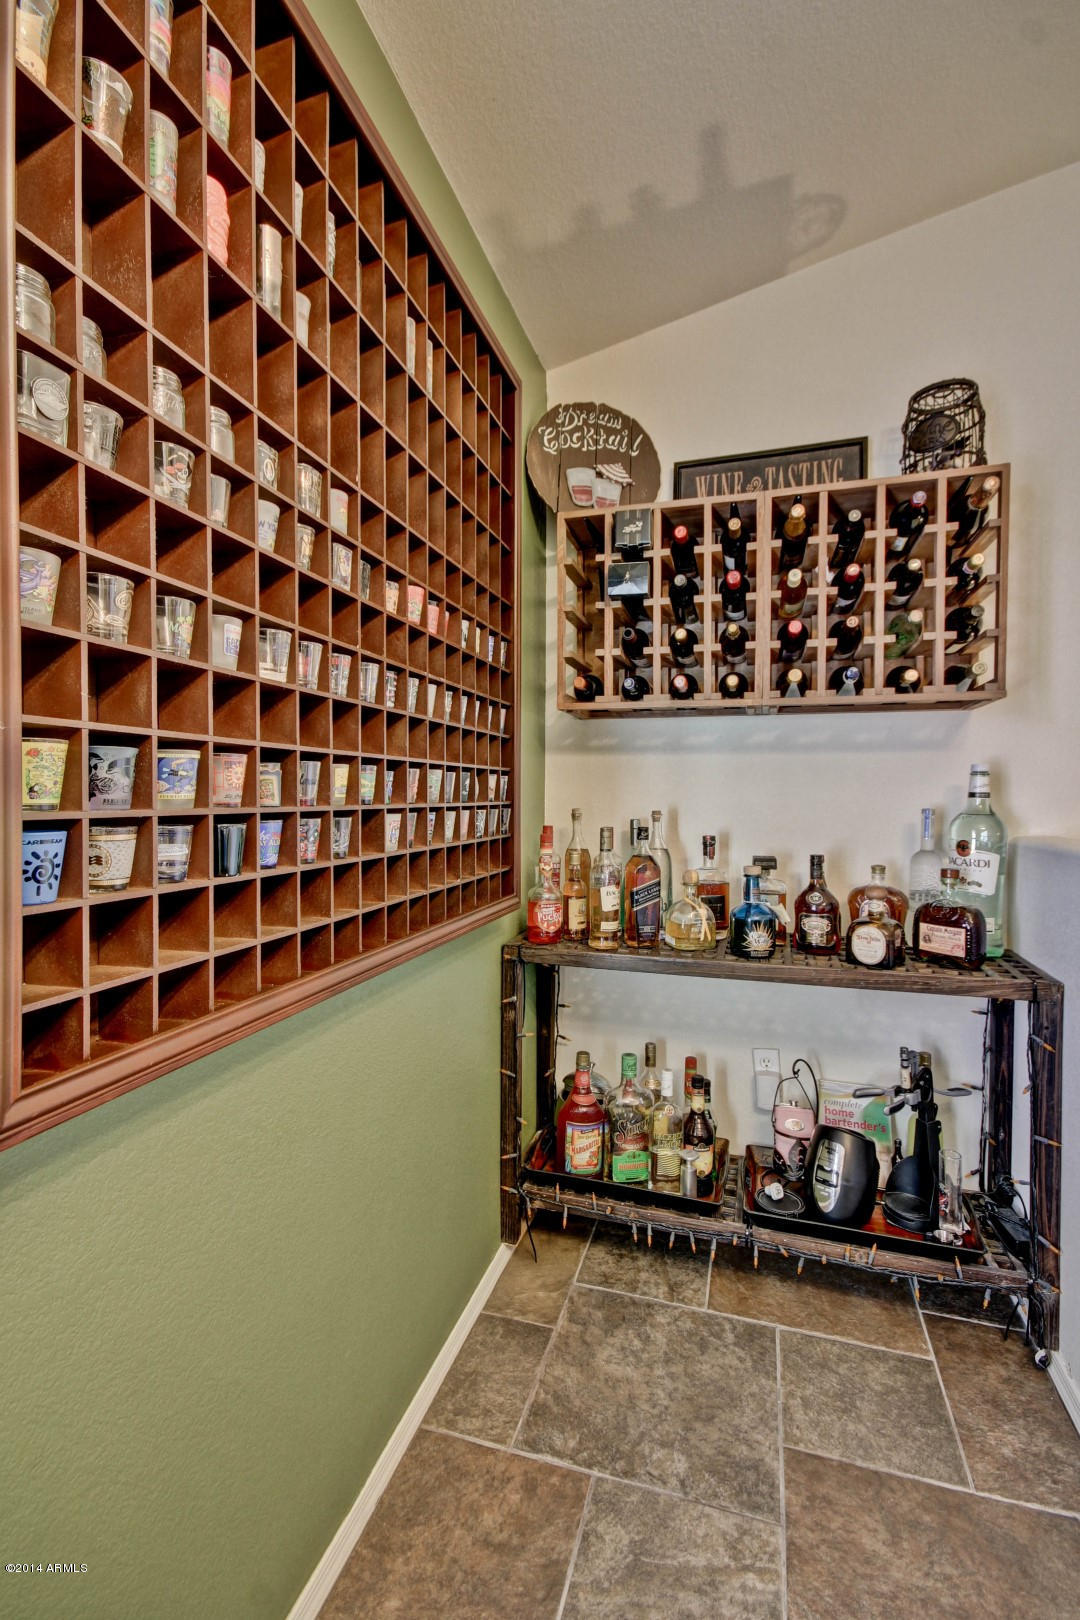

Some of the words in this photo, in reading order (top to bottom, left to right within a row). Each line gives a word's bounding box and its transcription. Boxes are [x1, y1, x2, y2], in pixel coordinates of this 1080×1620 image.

[556, 408, 622, 430] Dream
[538, 425, 643, 456] Cocktail
[696, 471, 743, 498] WINE
[765, 458, 844, 490] TASTING
[948, 856, 991, 868] ACARDI
[824, 1105, 855, 1119] home
[824, 1115, 887, 1134] bartender's
